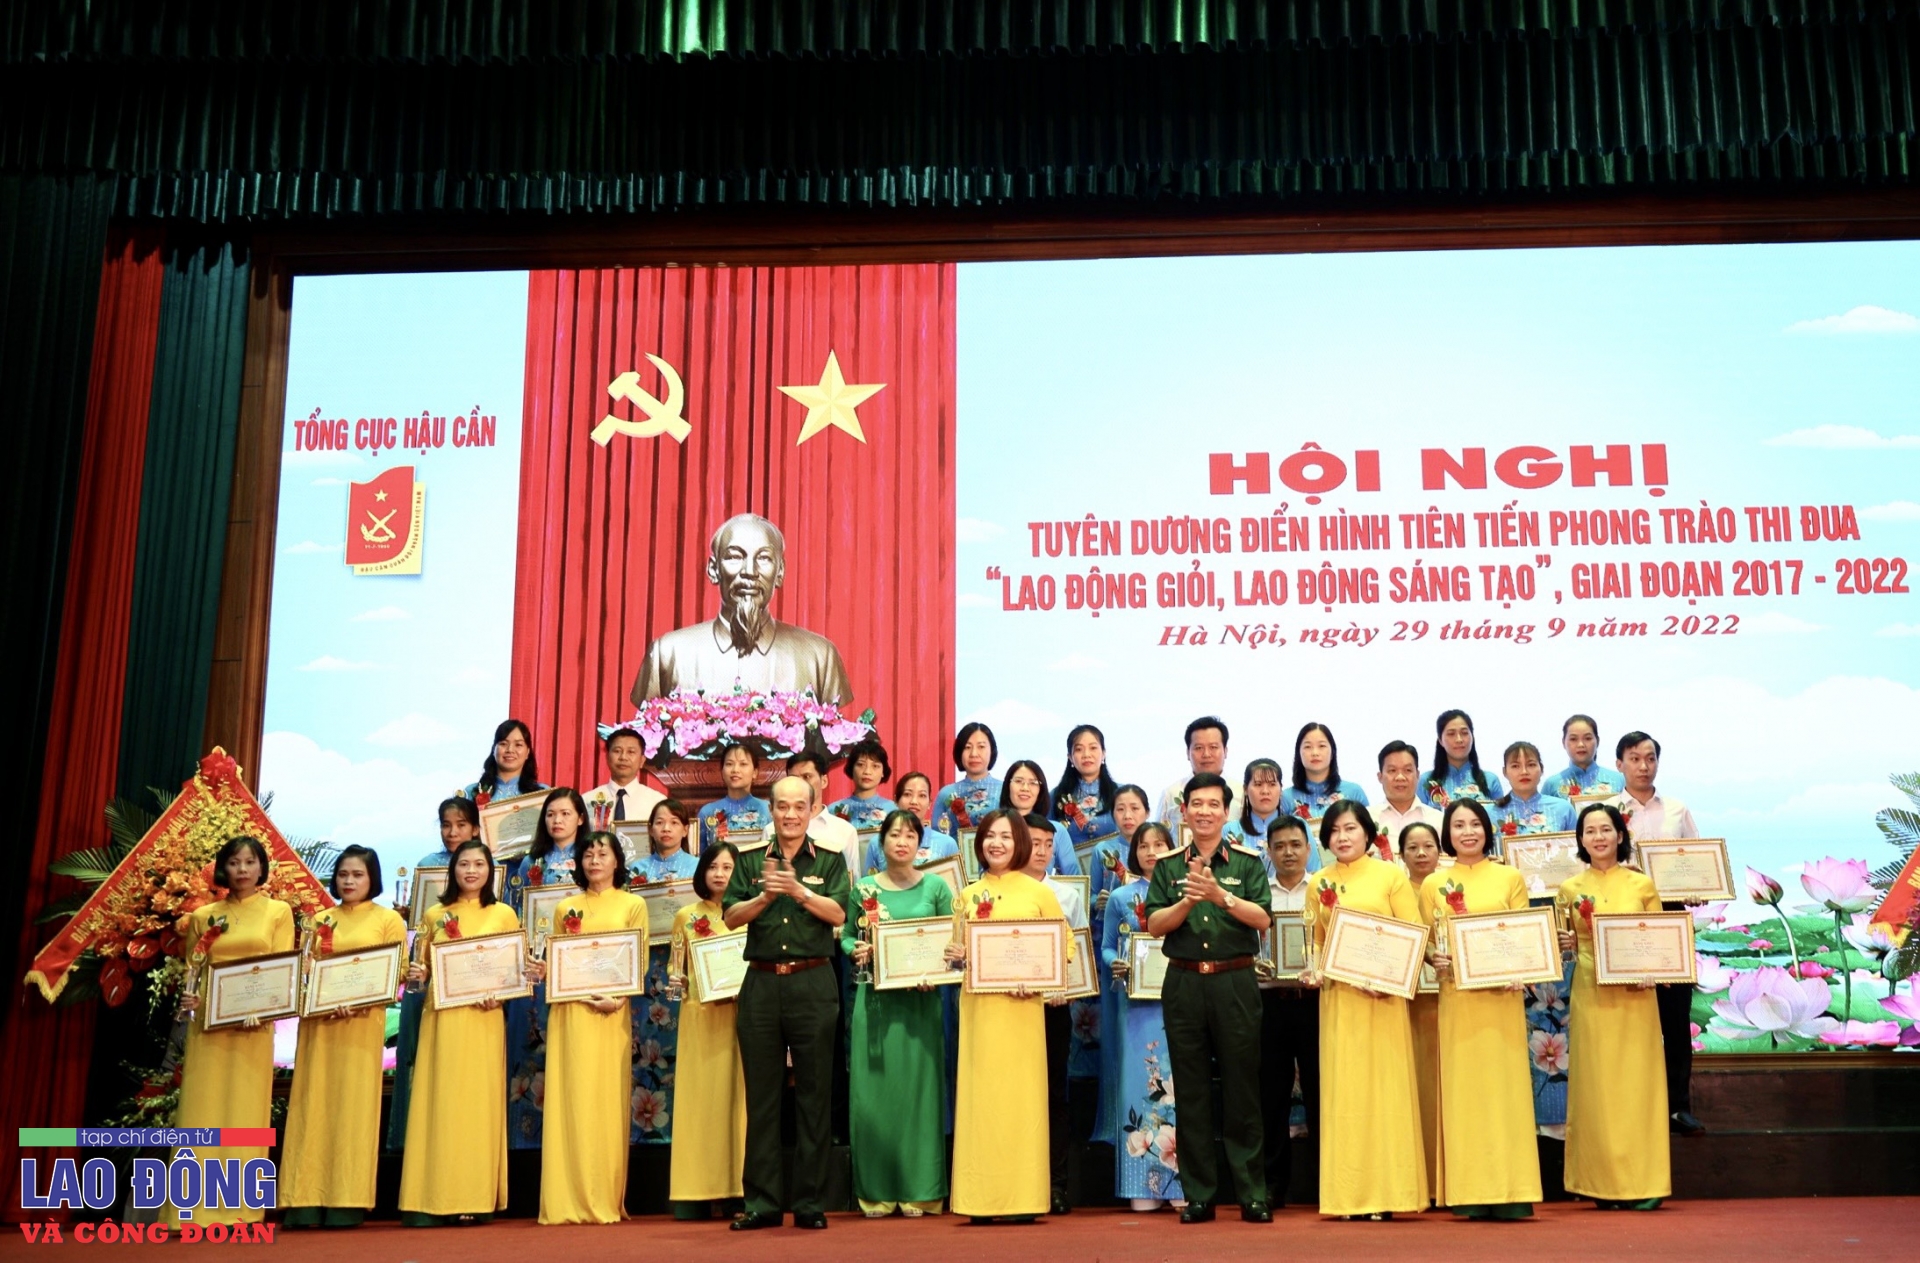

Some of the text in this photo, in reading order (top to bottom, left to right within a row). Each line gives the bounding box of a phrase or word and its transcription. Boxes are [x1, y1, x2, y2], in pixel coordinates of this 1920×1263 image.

[294, 406, 496, 456] TỔNG CỤC HẬU CẦN
[1209, 442, 1668, 505] HỘI NGHỊ
[1028, 500, 1860, 557] TUYÊN DƯƠNG ĐIỂN HÌNH TIÊN TIẾN PHONG TRÀO THI ĐUA
[1065, 566, 1146, 617] ĐỘNG
[1157, 560, 1224, 611] GIỎI,
[1235, 570, 1288, 605] LAO
[1297, 561, 1379, 612] ĐỘNG
[1390, 559, 1470, 603] SÁNG
[1572, 563, 1631, 599] GIAI
[1640, 561, 1723, 605] ĐOẠN
[1732, 560, 1803, 596] 2017
[1836, 558, 1909, 594] 2022
[1159, 615, 1739, 649] Hà Nội, ngày 29 tháng 9 năm 2022
